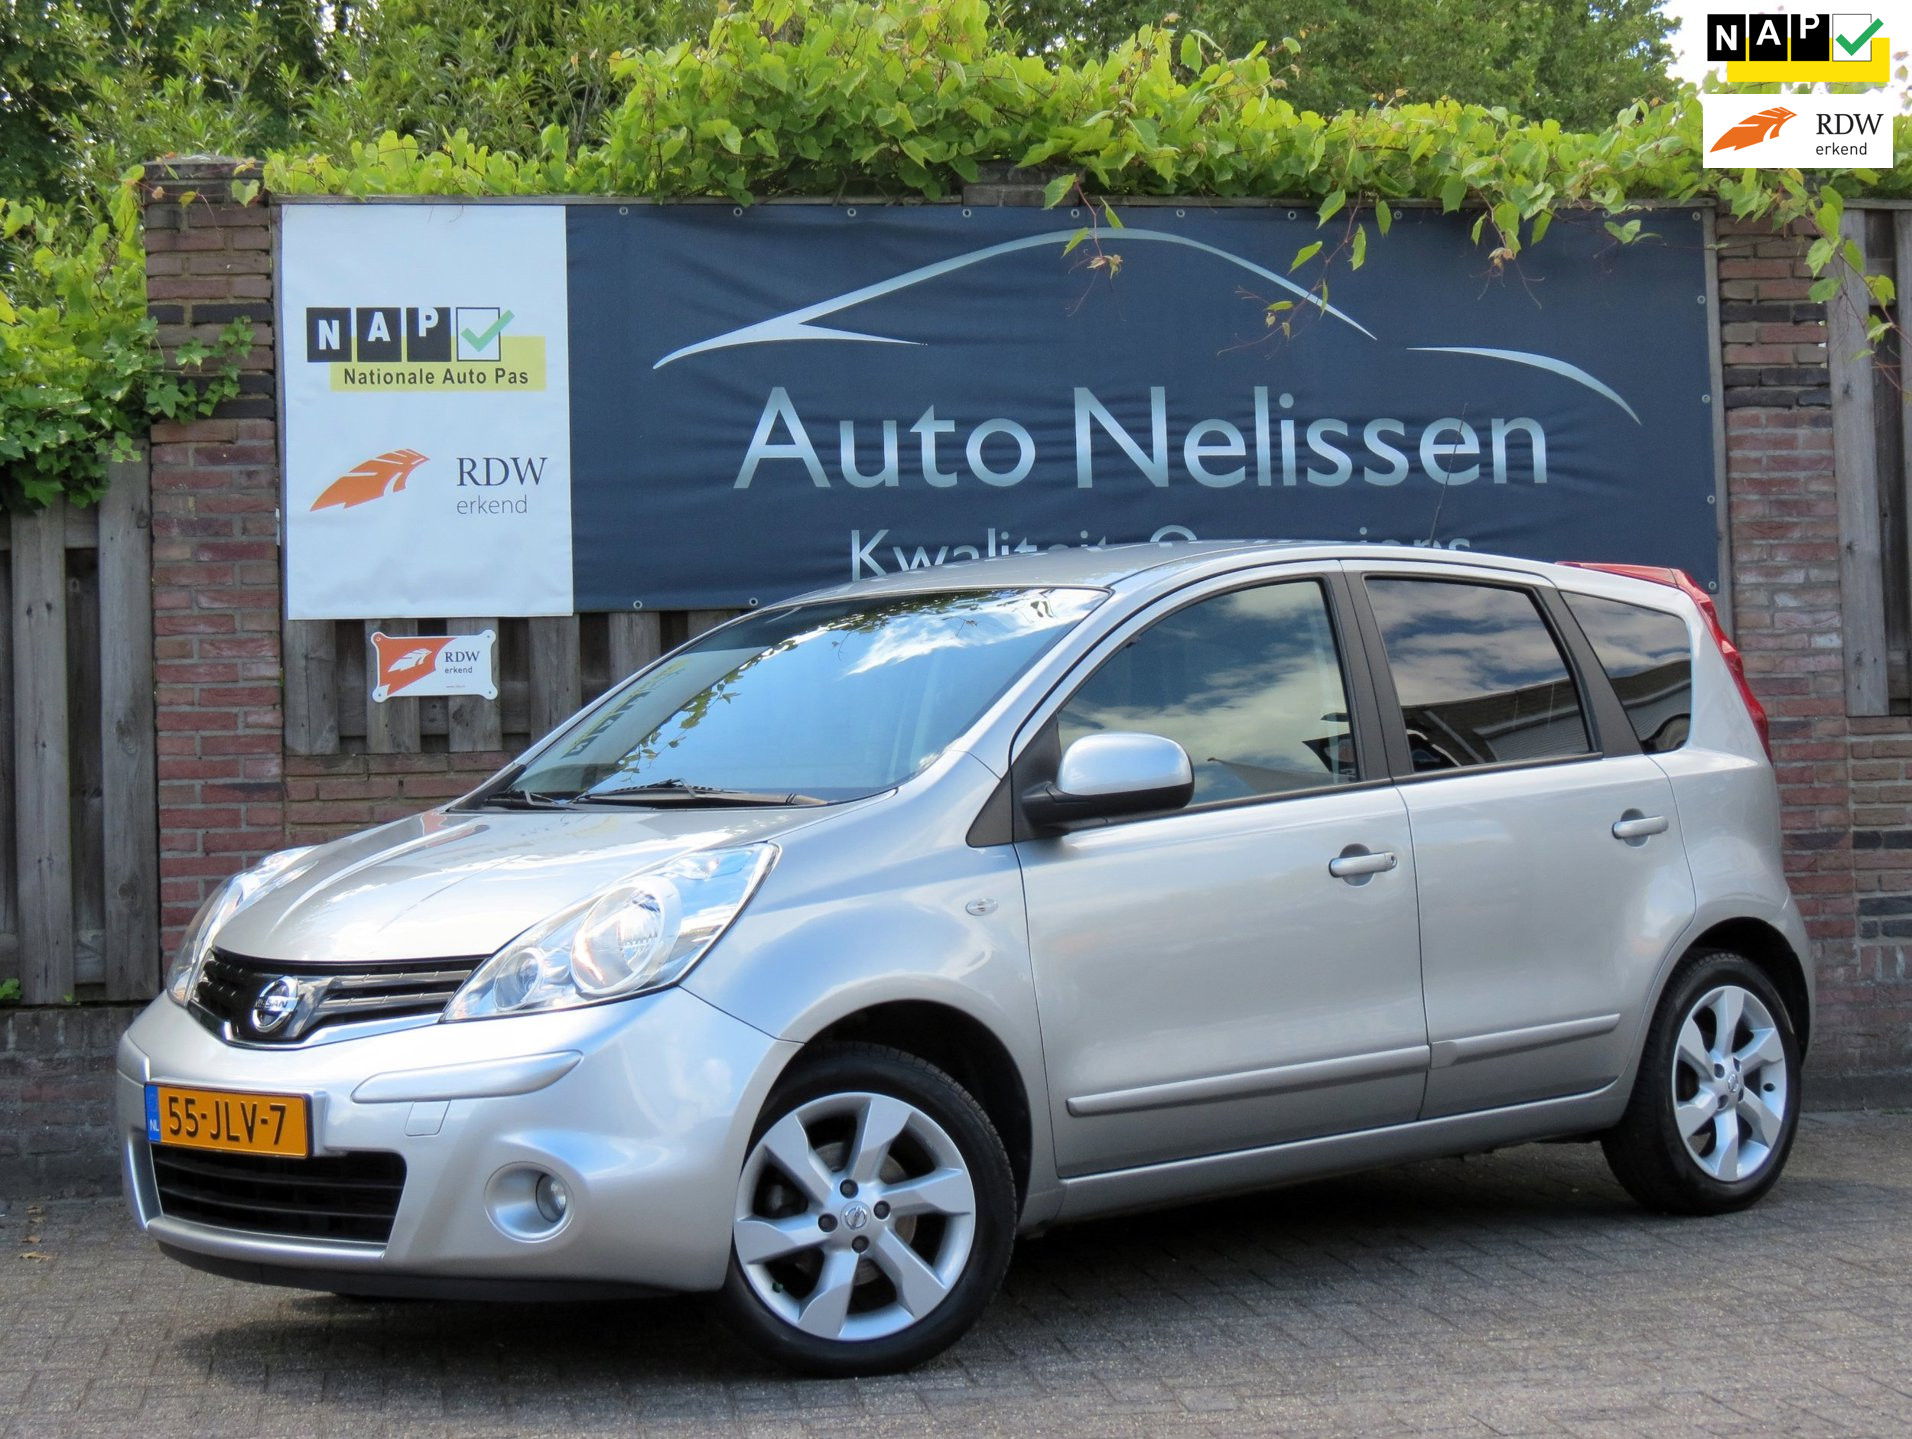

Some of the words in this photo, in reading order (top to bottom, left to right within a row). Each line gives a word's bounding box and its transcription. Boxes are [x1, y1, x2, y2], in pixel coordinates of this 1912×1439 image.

[318, 307, 440, 350] NAP
[343, 367, 436, 385] Nationale
[442, 367, 487, 385] Auto
[494, 367, 529, 385] Pas
[732, 386, 1037, 489] Auto
[1074, 385, 1548, 489] Nelissen
[456, 457, 548, 487] RDW
[456, 494, 528, 515] erkend
[444, 651, 480, 663] RDW
[444, 666, 473, 674] erkend
[149, 1118, 160, 1132] NL
[168, 1095, 288, 1145] 55-JLV-7
